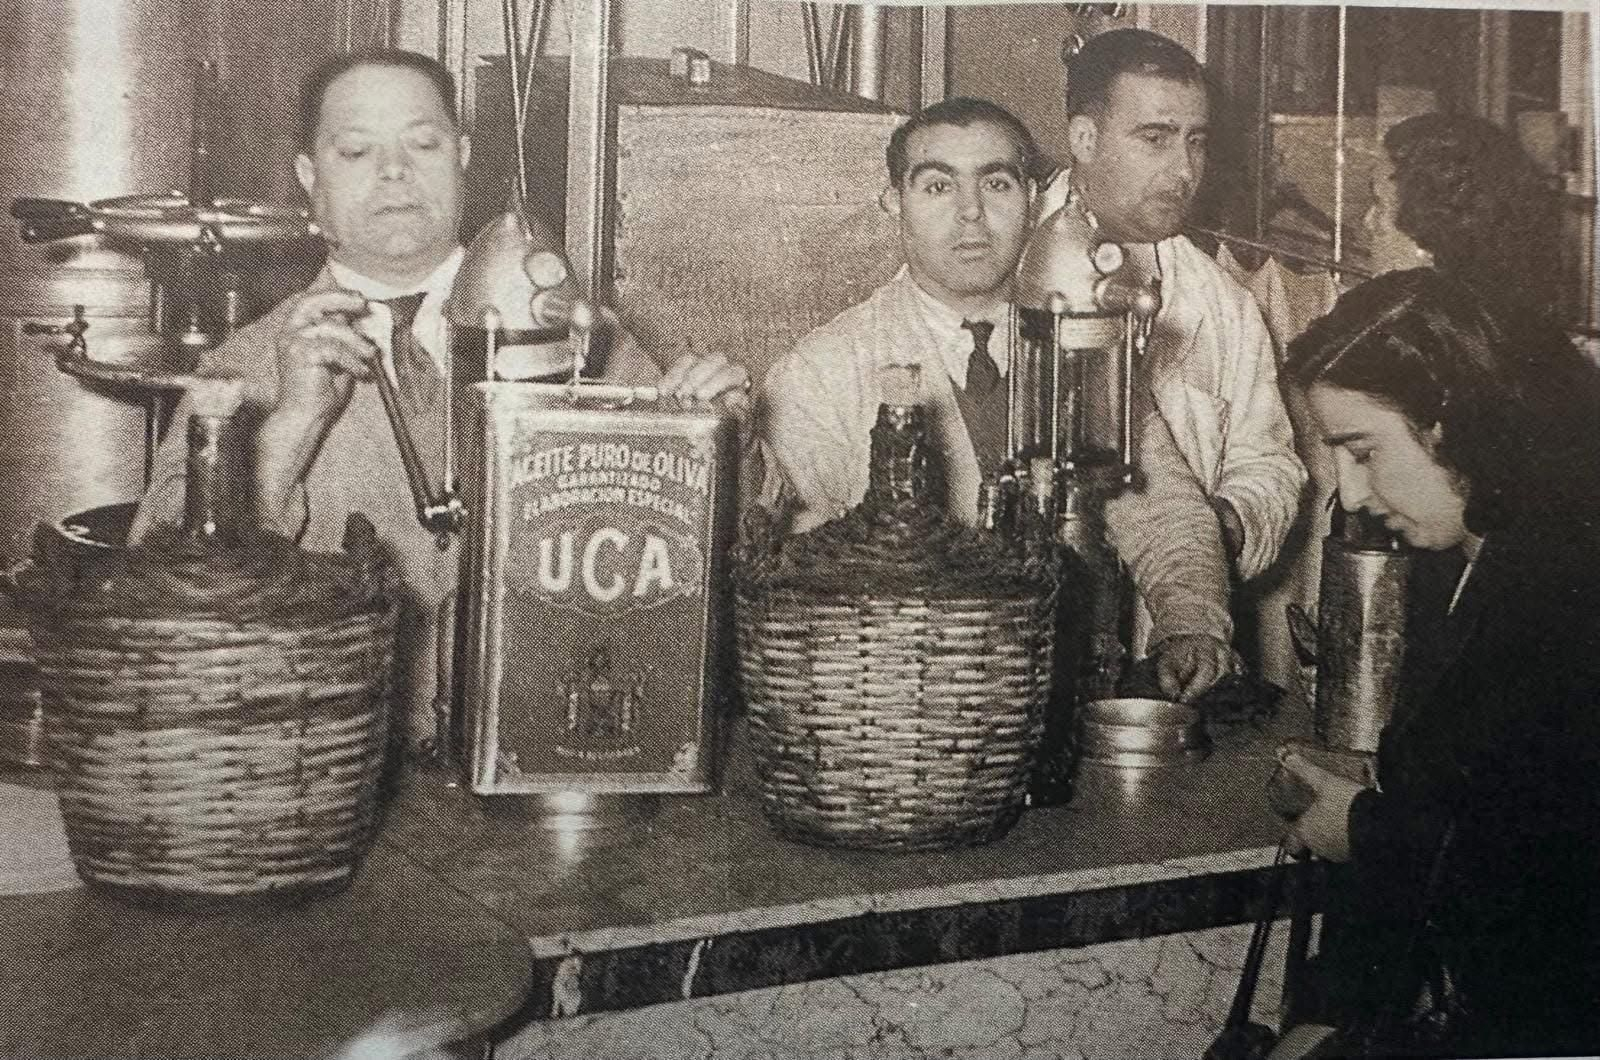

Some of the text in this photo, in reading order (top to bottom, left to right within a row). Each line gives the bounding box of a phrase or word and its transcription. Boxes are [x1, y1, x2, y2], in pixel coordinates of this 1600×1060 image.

[511, 443, 709, 495] ACEITE PURO DE OLIVA
[627, 489, 693, 524] ESPECIAL
[538, 527, 674, 602] UCA
